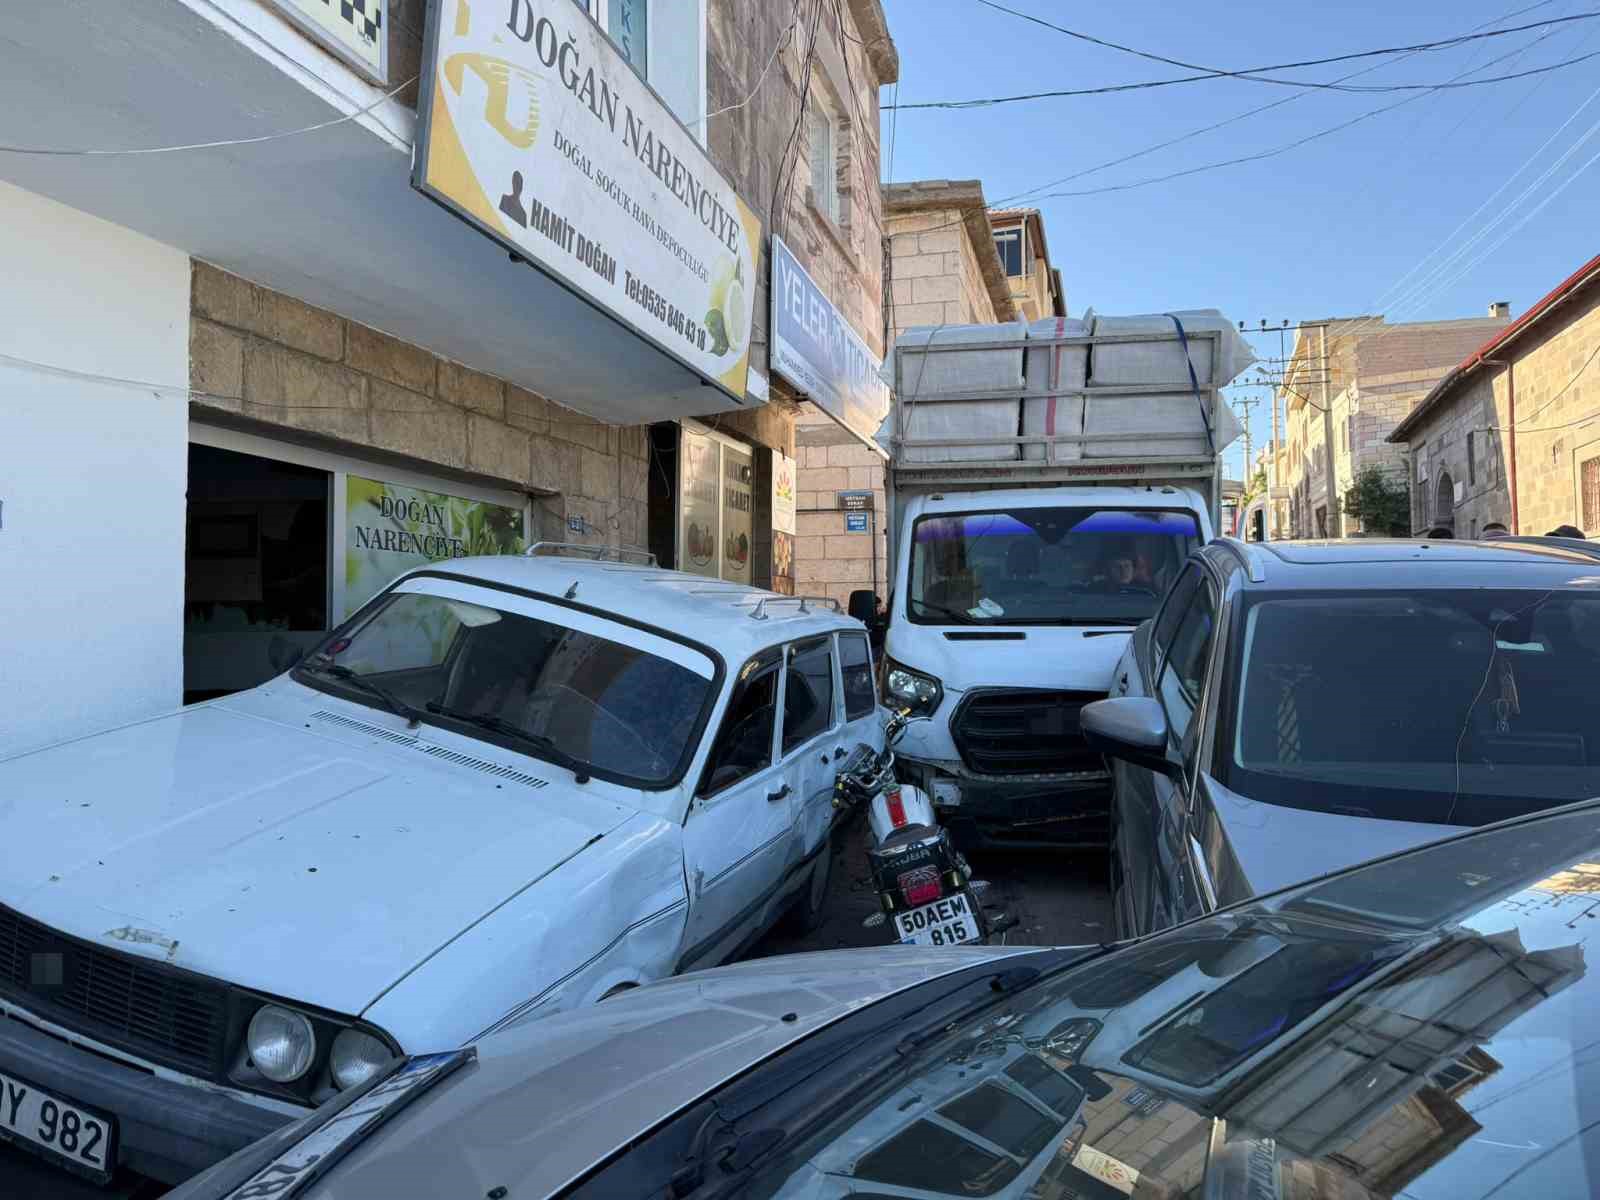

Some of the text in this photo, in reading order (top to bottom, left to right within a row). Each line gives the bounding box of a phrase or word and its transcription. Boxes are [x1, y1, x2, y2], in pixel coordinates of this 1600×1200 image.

[506, 0, 740, 254] DOĞAN NARENCİYE
[553, 130, 593, 180] DOĞAL
[595, 169, 631, 214] SOĞUK
[632, 202, 656, 237] HAVA
[530, 198, 575, 253] HAMİT
[576, 233, 617, 285] DOĞAN
[624, 269, 666, 322] Tel:0535
[667, 303, 685, 336] 846
[684, 317, 696, 344] 43
[355, 526, 466, 559] NARENCİYE
[380, 495, 446, 526] DOĞAN
[931, 920, 967, 946] 815
[0, 1079, 103, 1164] Y 982
